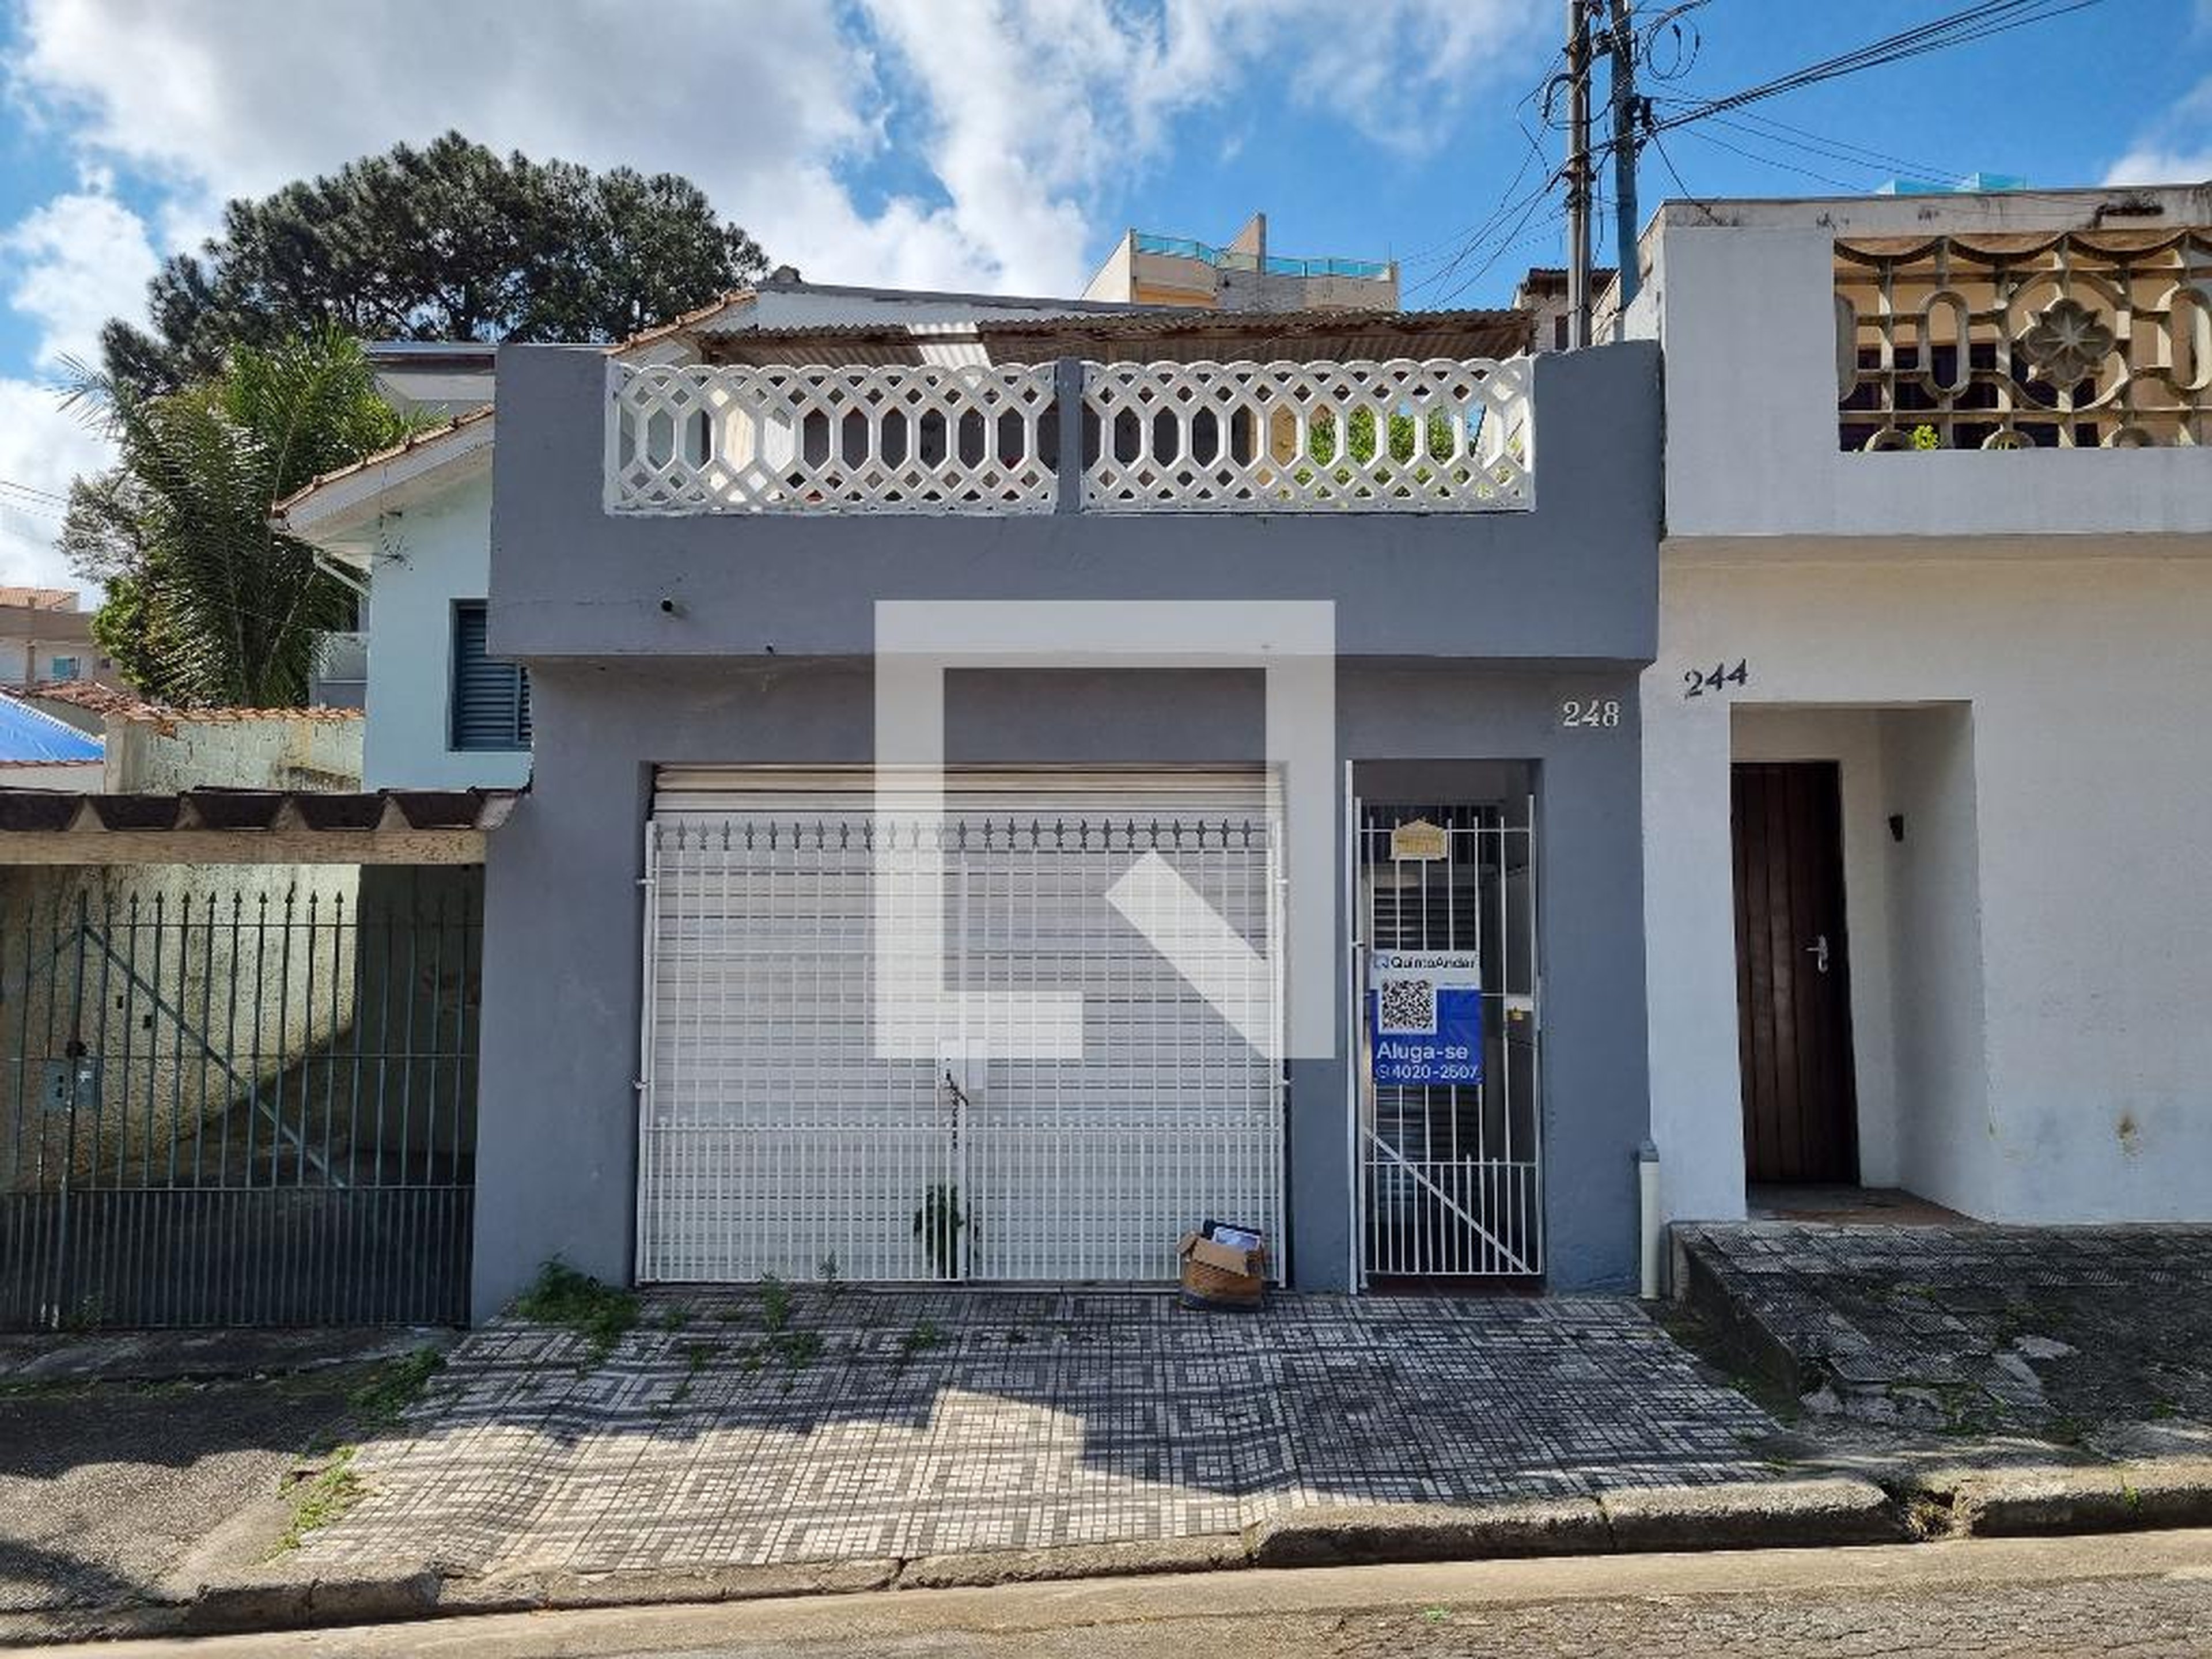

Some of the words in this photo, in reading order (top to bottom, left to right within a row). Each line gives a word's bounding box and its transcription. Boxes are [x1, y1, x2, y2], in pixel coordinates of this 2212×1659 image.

[1684, 658, 1748, 699] 244
[1563, 700, 1620, 727] 248
[1377, 1041, 1469, 1063] Aluga-se
